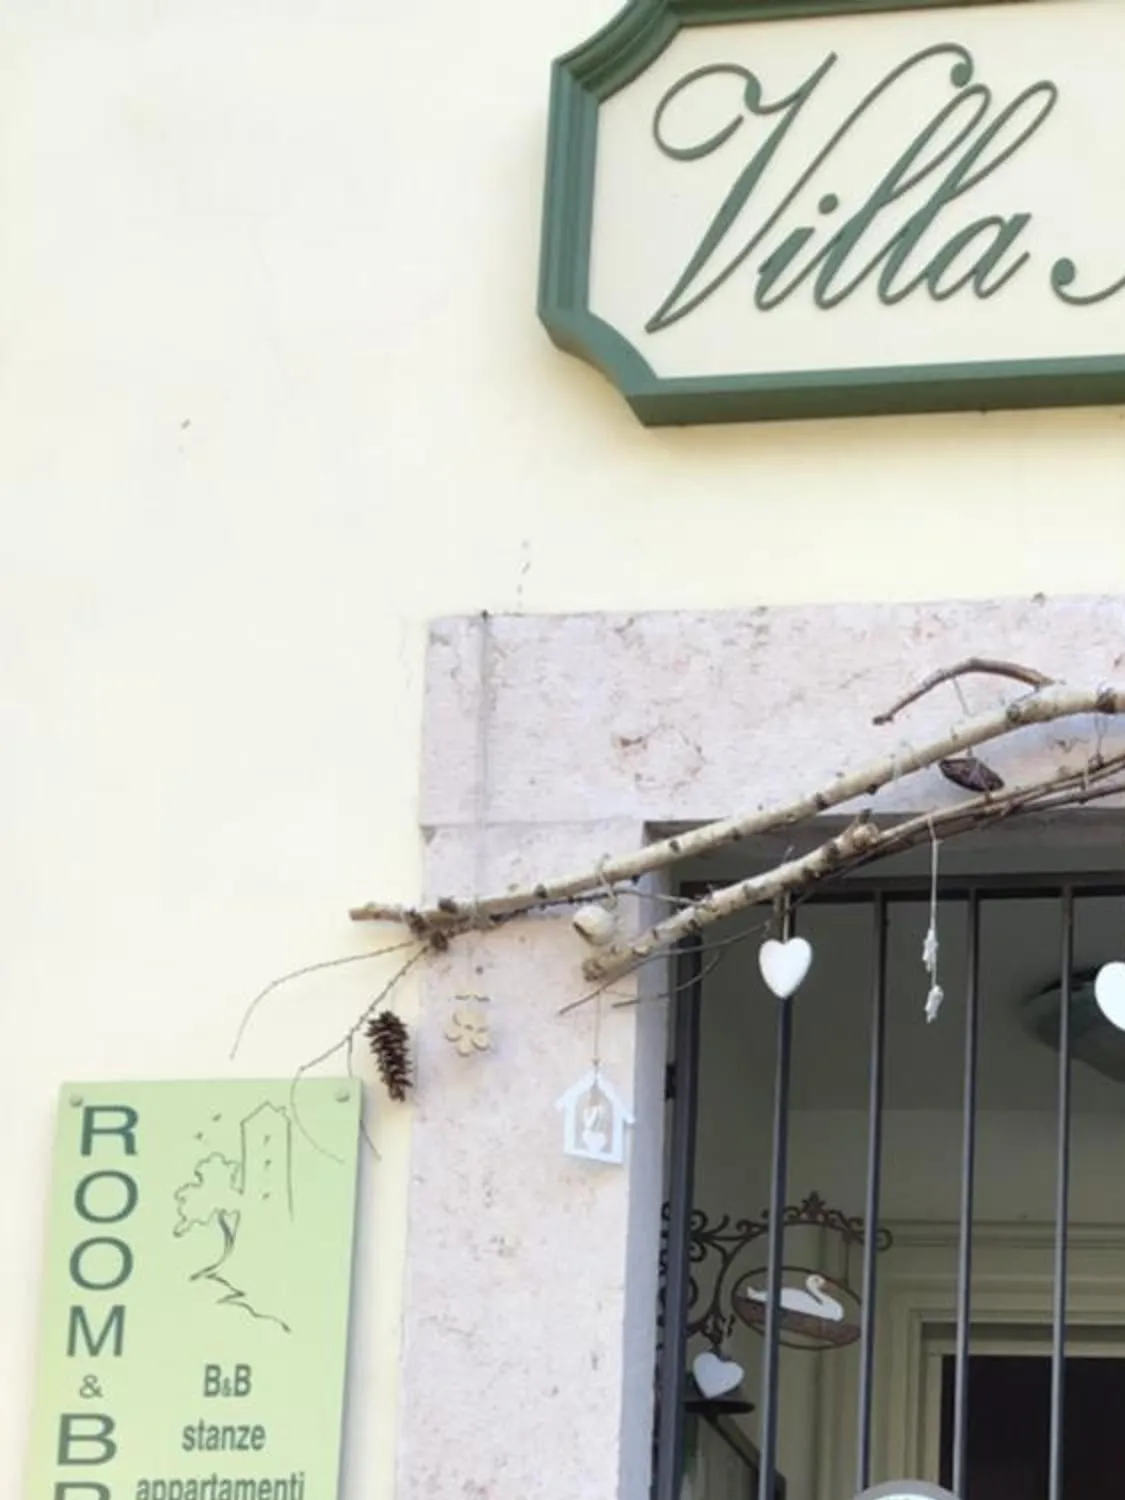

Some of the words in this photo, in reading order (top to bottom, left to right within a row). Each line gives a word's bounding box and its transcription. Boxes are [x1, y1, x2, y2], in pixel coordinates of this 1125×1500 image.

[645, 42, 1058, 334] Villa
[67, 1105, 139, 1357] ROOM
[79, 1374, 103, 1399] &
[203, 1364, 252, 1397] B&B
[181, 1418, 266, 1451] stanze
